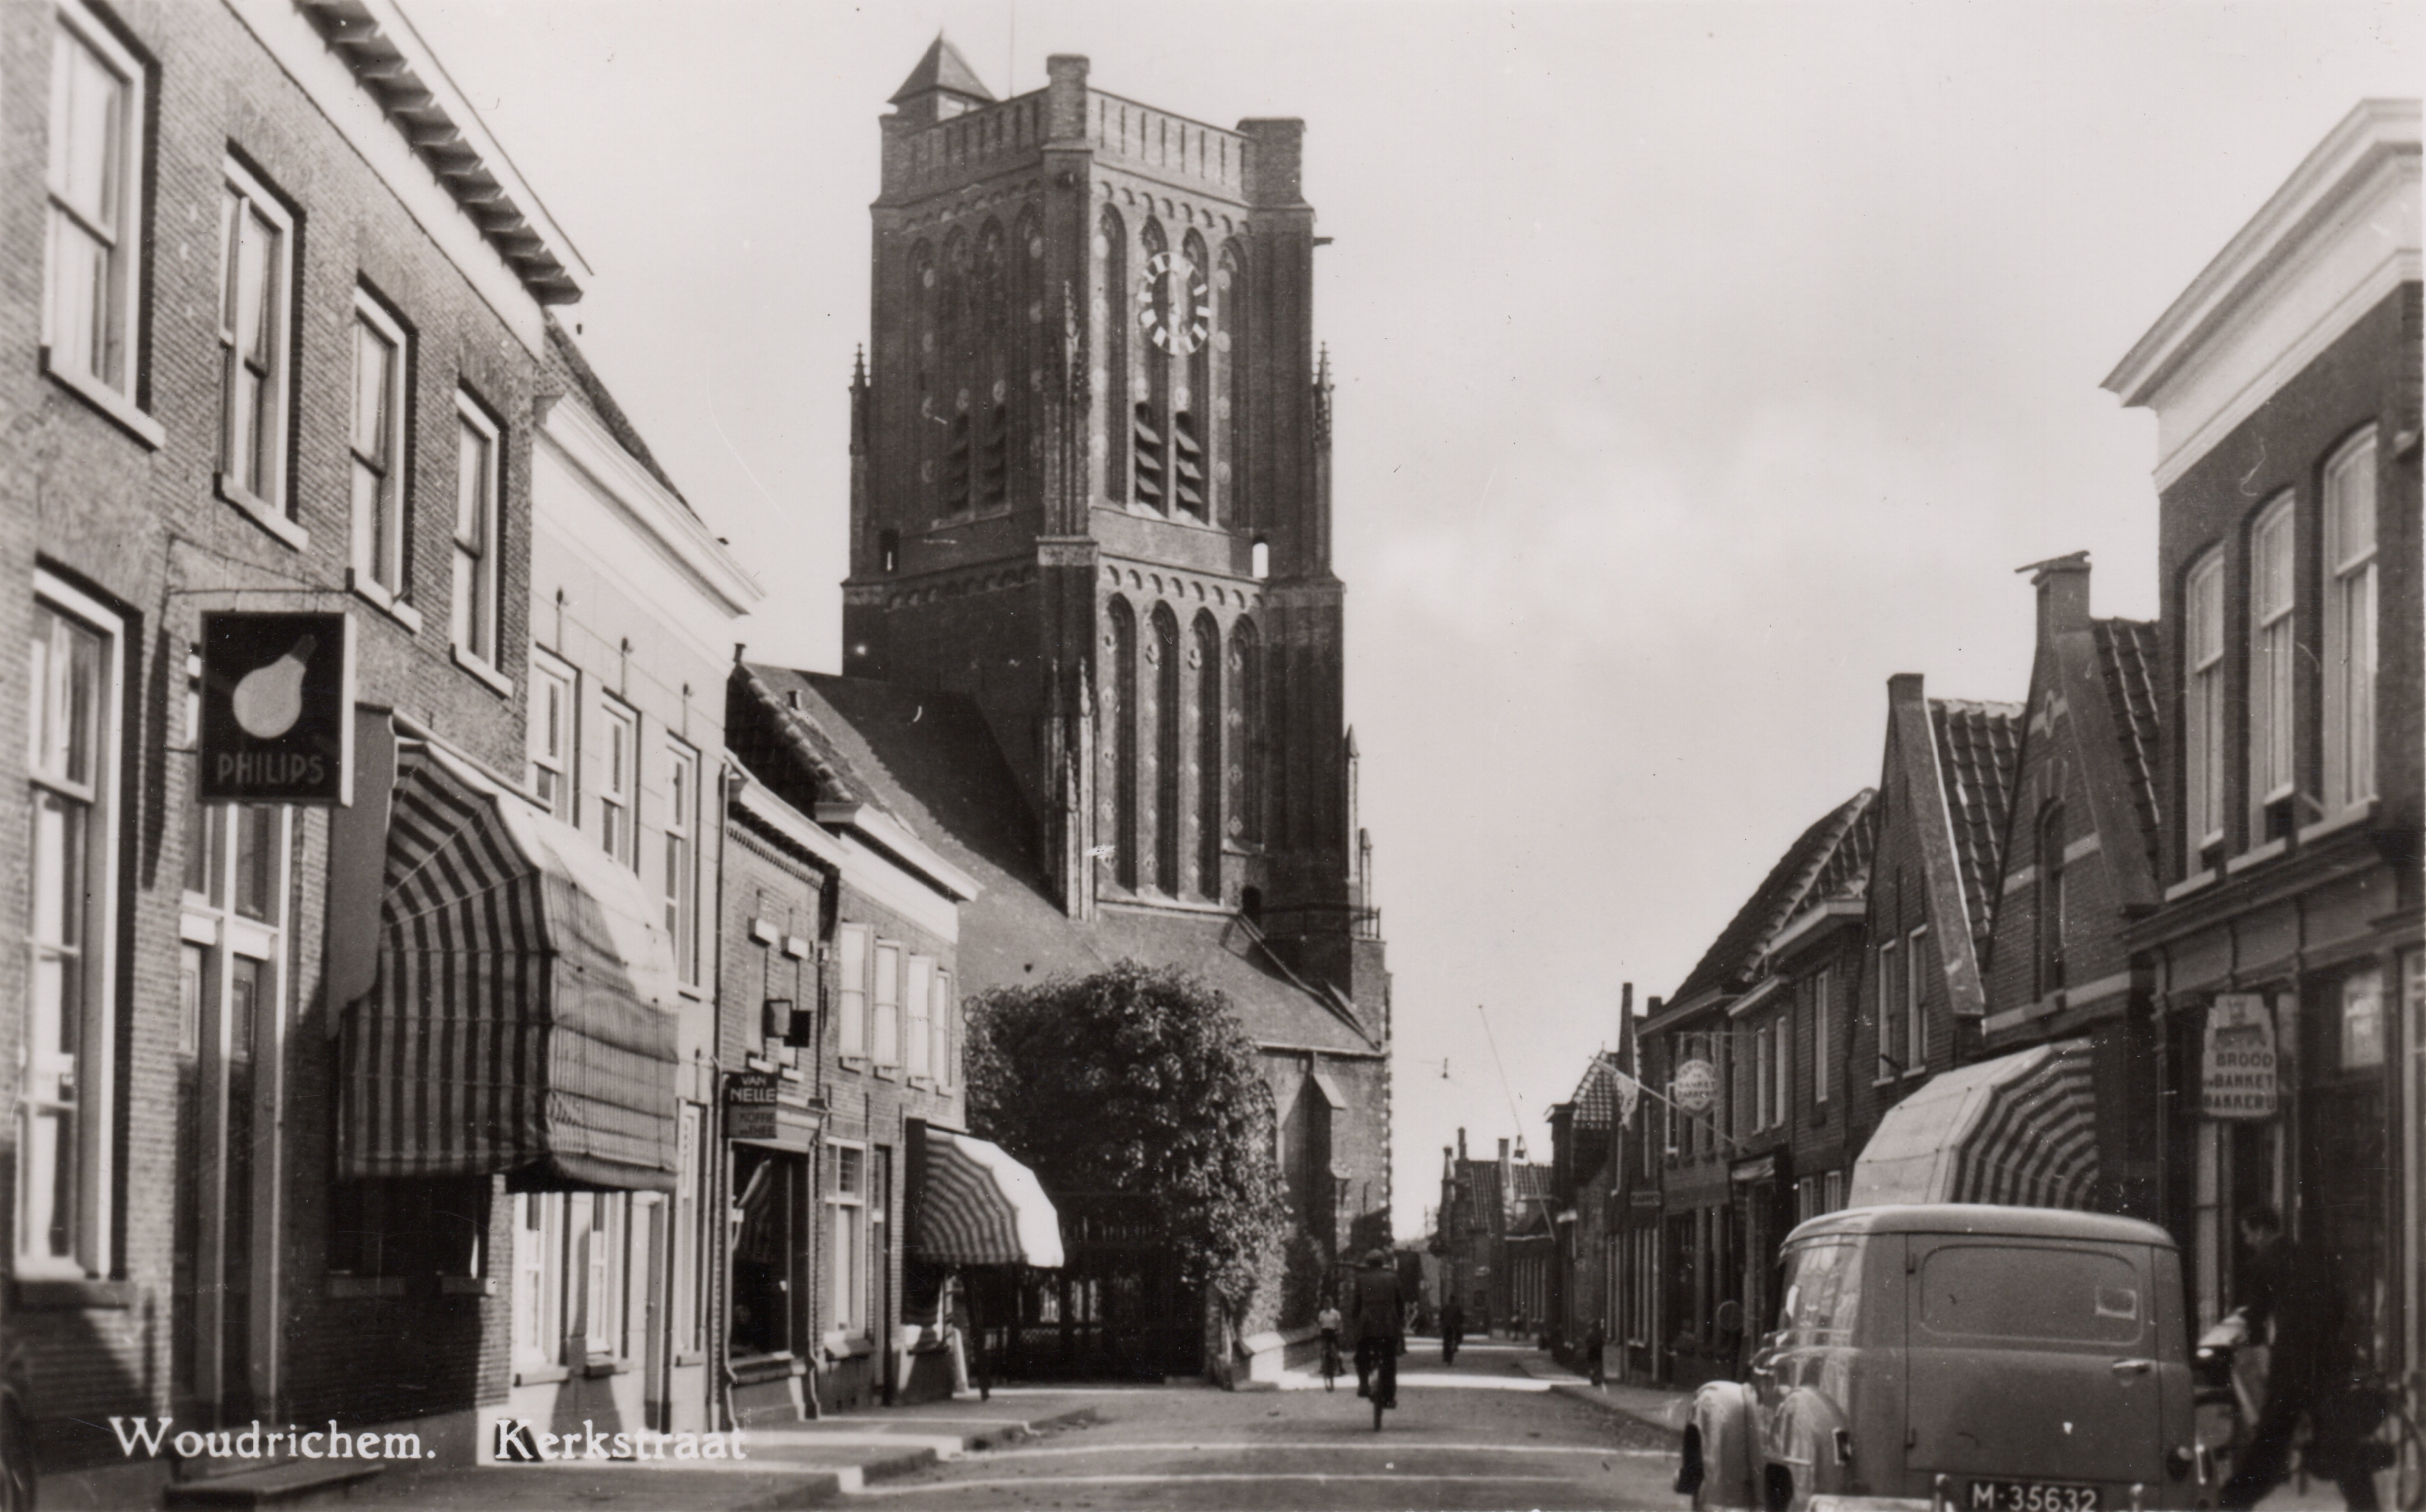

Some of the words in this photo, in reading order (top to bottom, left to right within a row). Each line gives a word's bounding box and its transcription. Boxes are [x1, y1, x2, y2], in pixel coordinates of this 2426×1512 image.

[217, 751, 326, 784] PHILIPS
[2216, 1052, 2273, 1067] BROOD
[741, 1075, 767, 1086] VAN
[729, 1088, 776, 1103] NELLE
